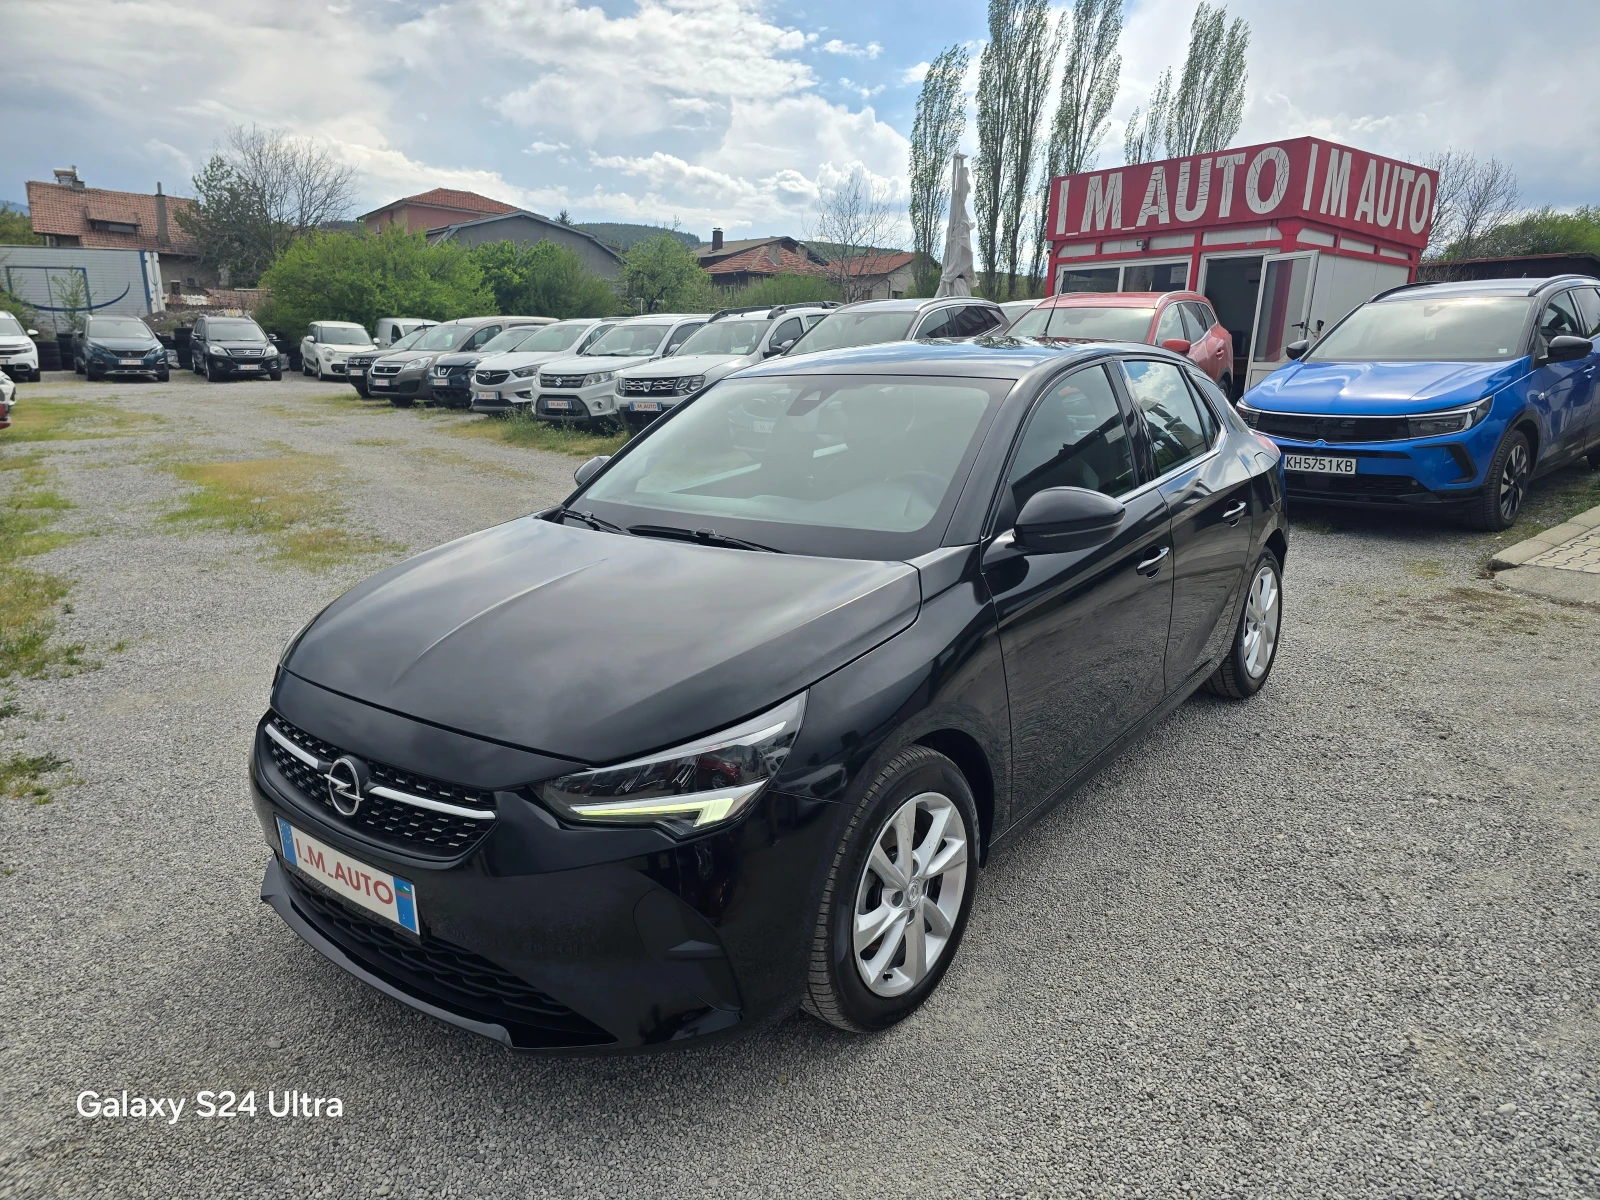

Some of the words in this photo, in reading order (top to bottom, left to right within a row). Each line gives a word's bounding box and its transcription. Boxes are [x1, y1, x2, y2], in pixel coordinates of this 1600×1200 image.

[1302, 143, 1319, 212] I
[1320, 148, 1352, 218] M
[1354, 158, 1431, 234] AUTO
